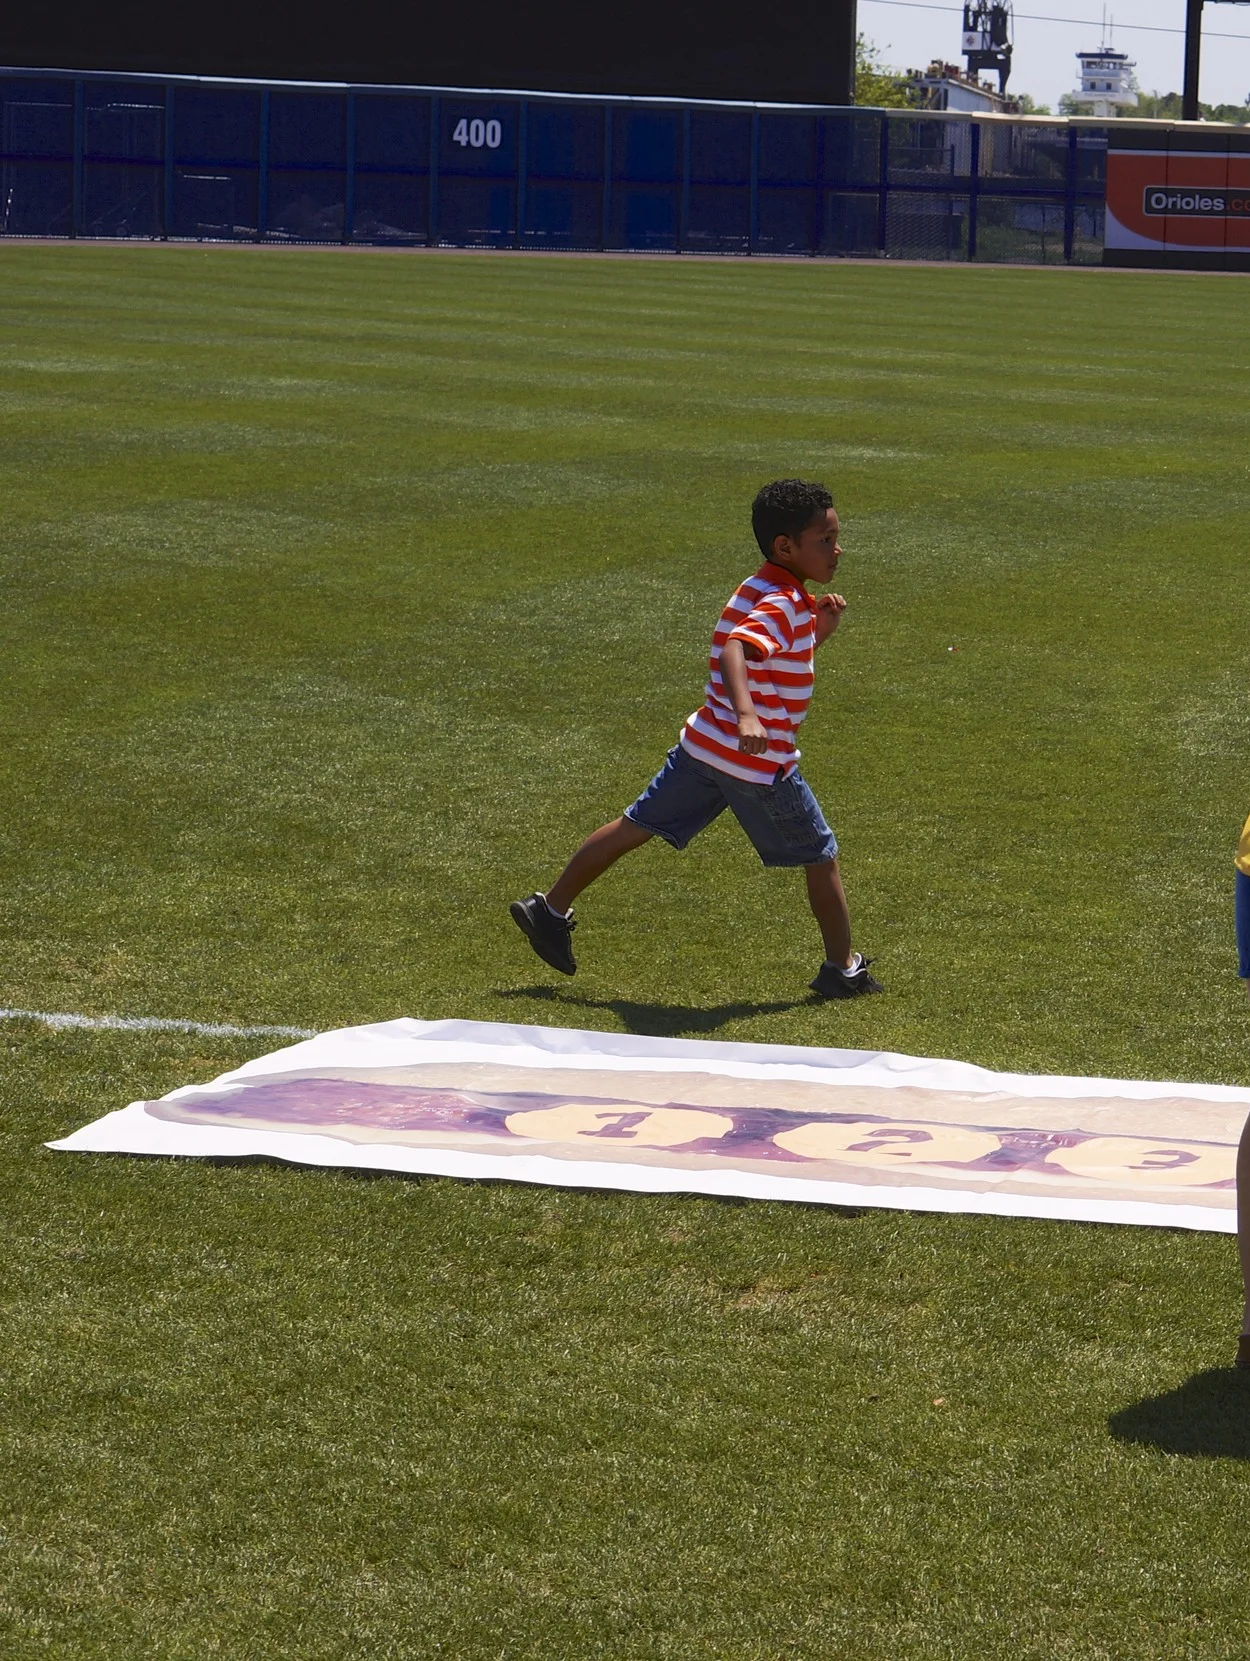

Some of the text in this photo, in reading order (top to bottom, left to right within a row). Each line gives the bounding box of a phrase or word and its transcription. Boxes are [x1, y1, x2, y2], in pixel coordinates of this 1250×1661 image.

[452, 118, 502, 148] 400
[576, 1111, 654, 1138] 1
[836, 1128, 934, 1157] 2
